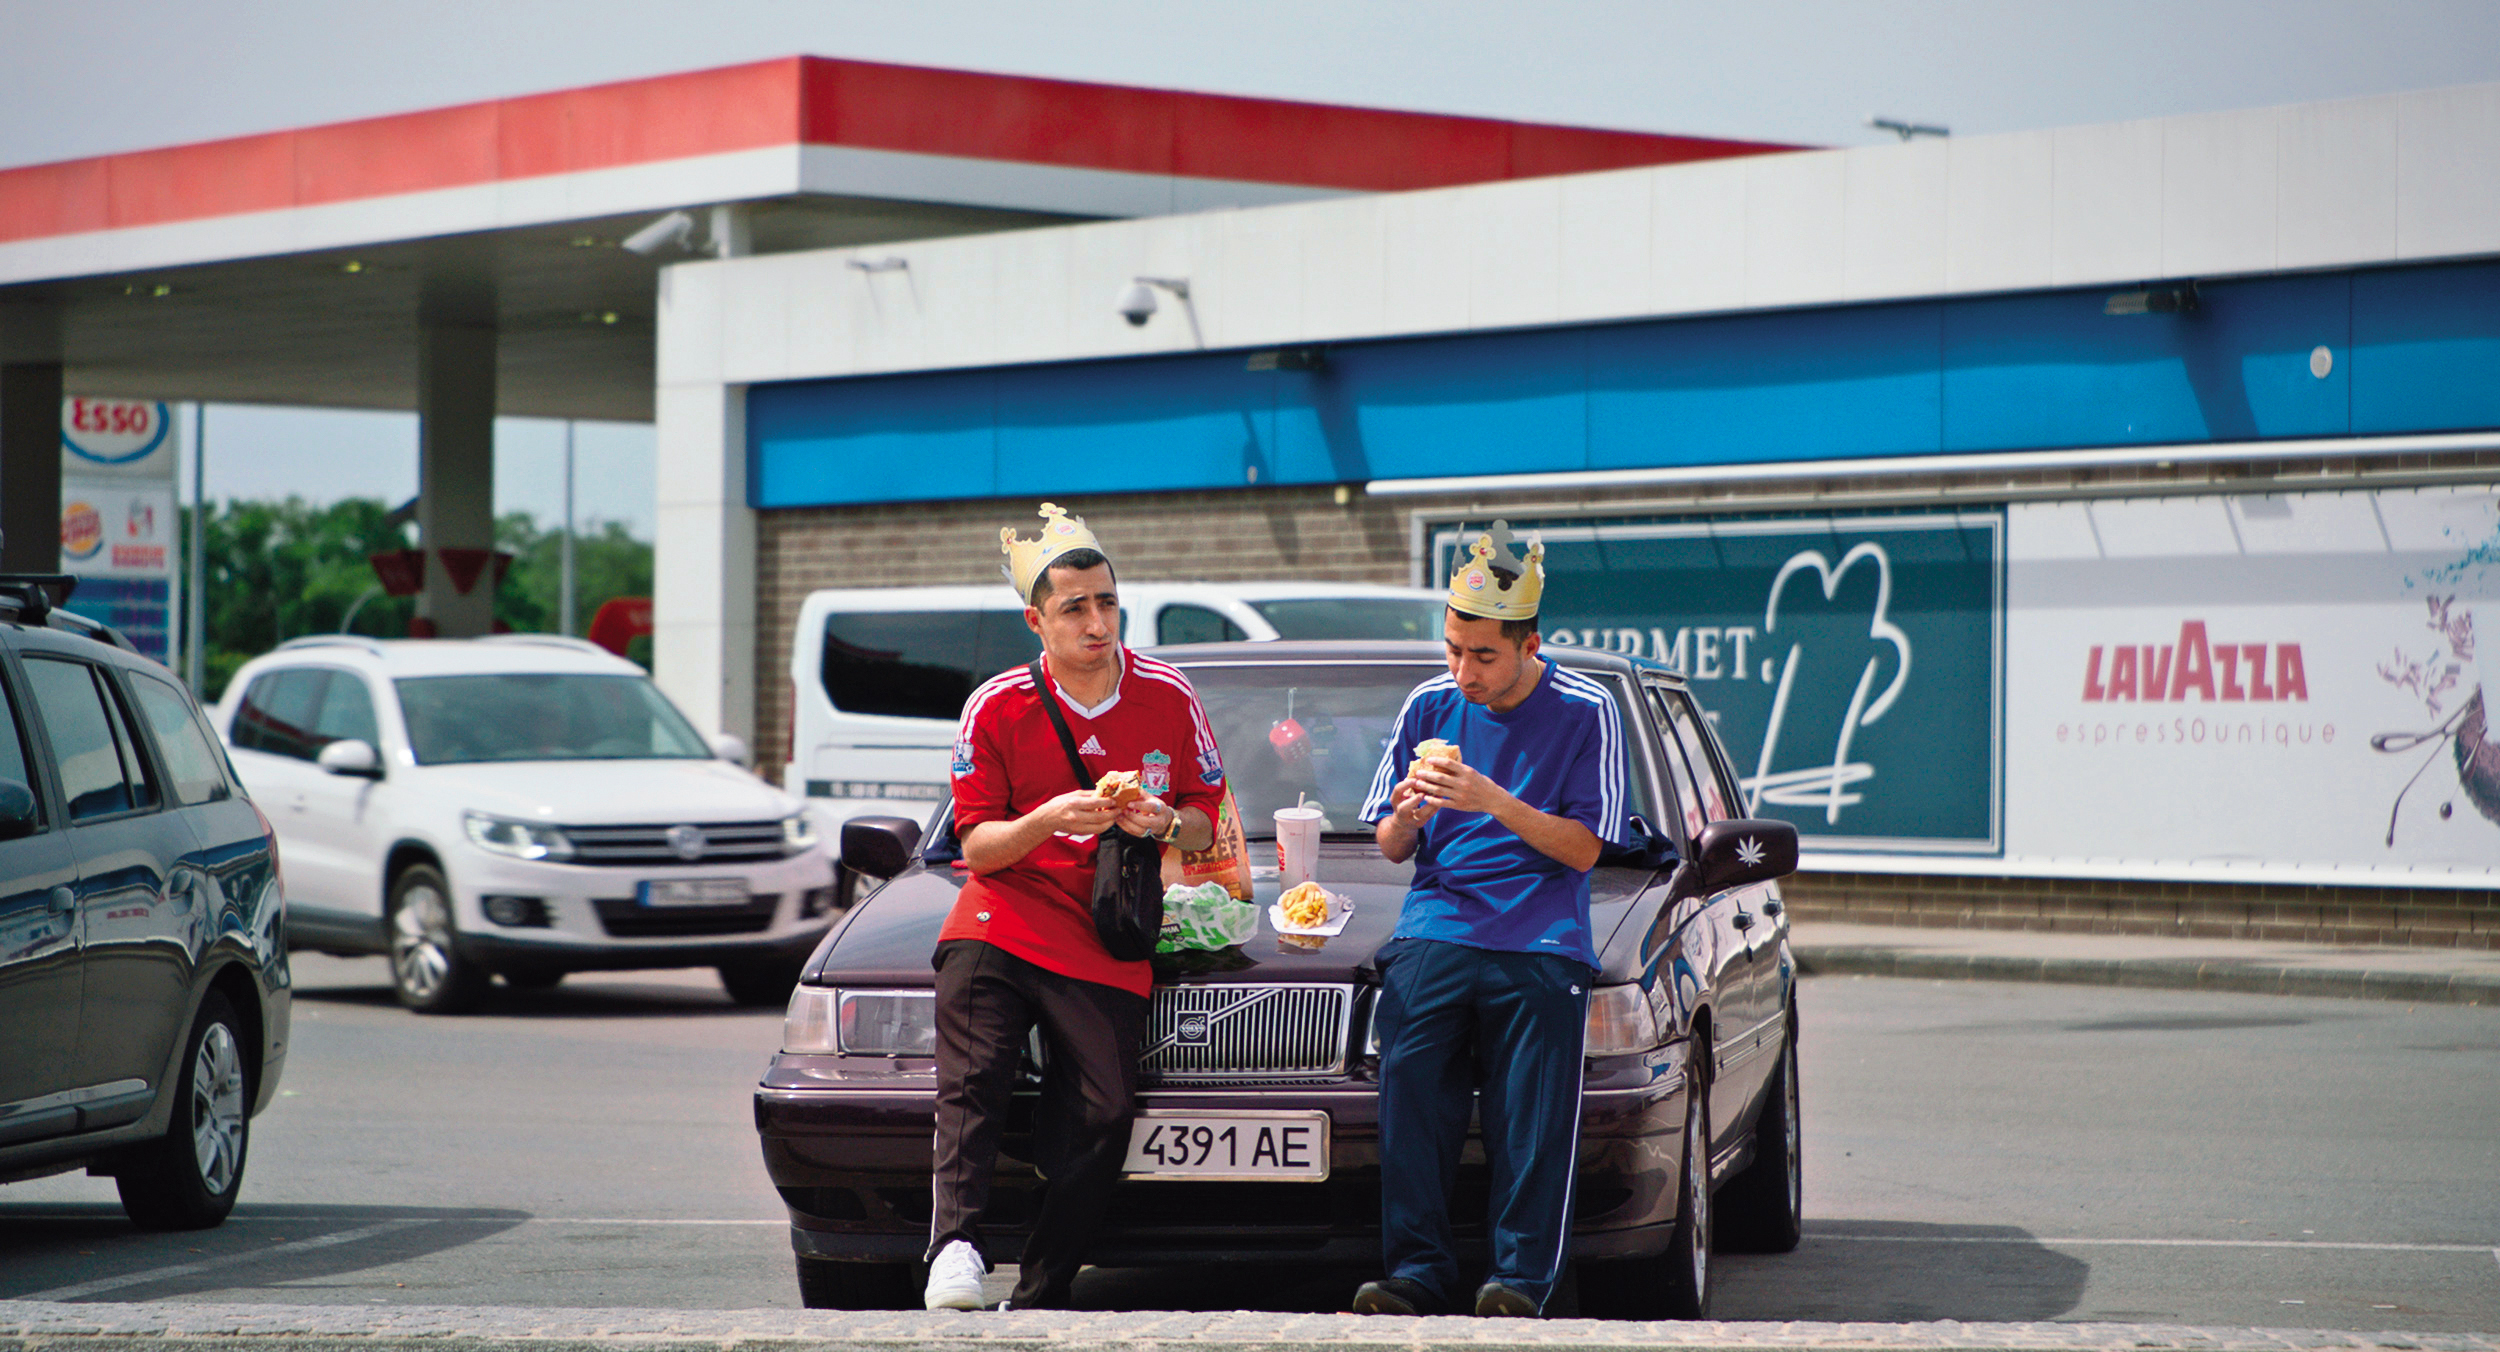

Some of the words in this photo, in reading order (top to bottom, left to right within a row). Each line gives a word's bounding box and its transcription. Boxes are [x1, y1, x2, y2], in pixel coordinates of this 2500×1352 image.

[2081, 619, 2309, 702] LAVAZZA
[1142, 1125, 1237, 1167] 4391
[1251, 1126, 1311, 1168] AE
